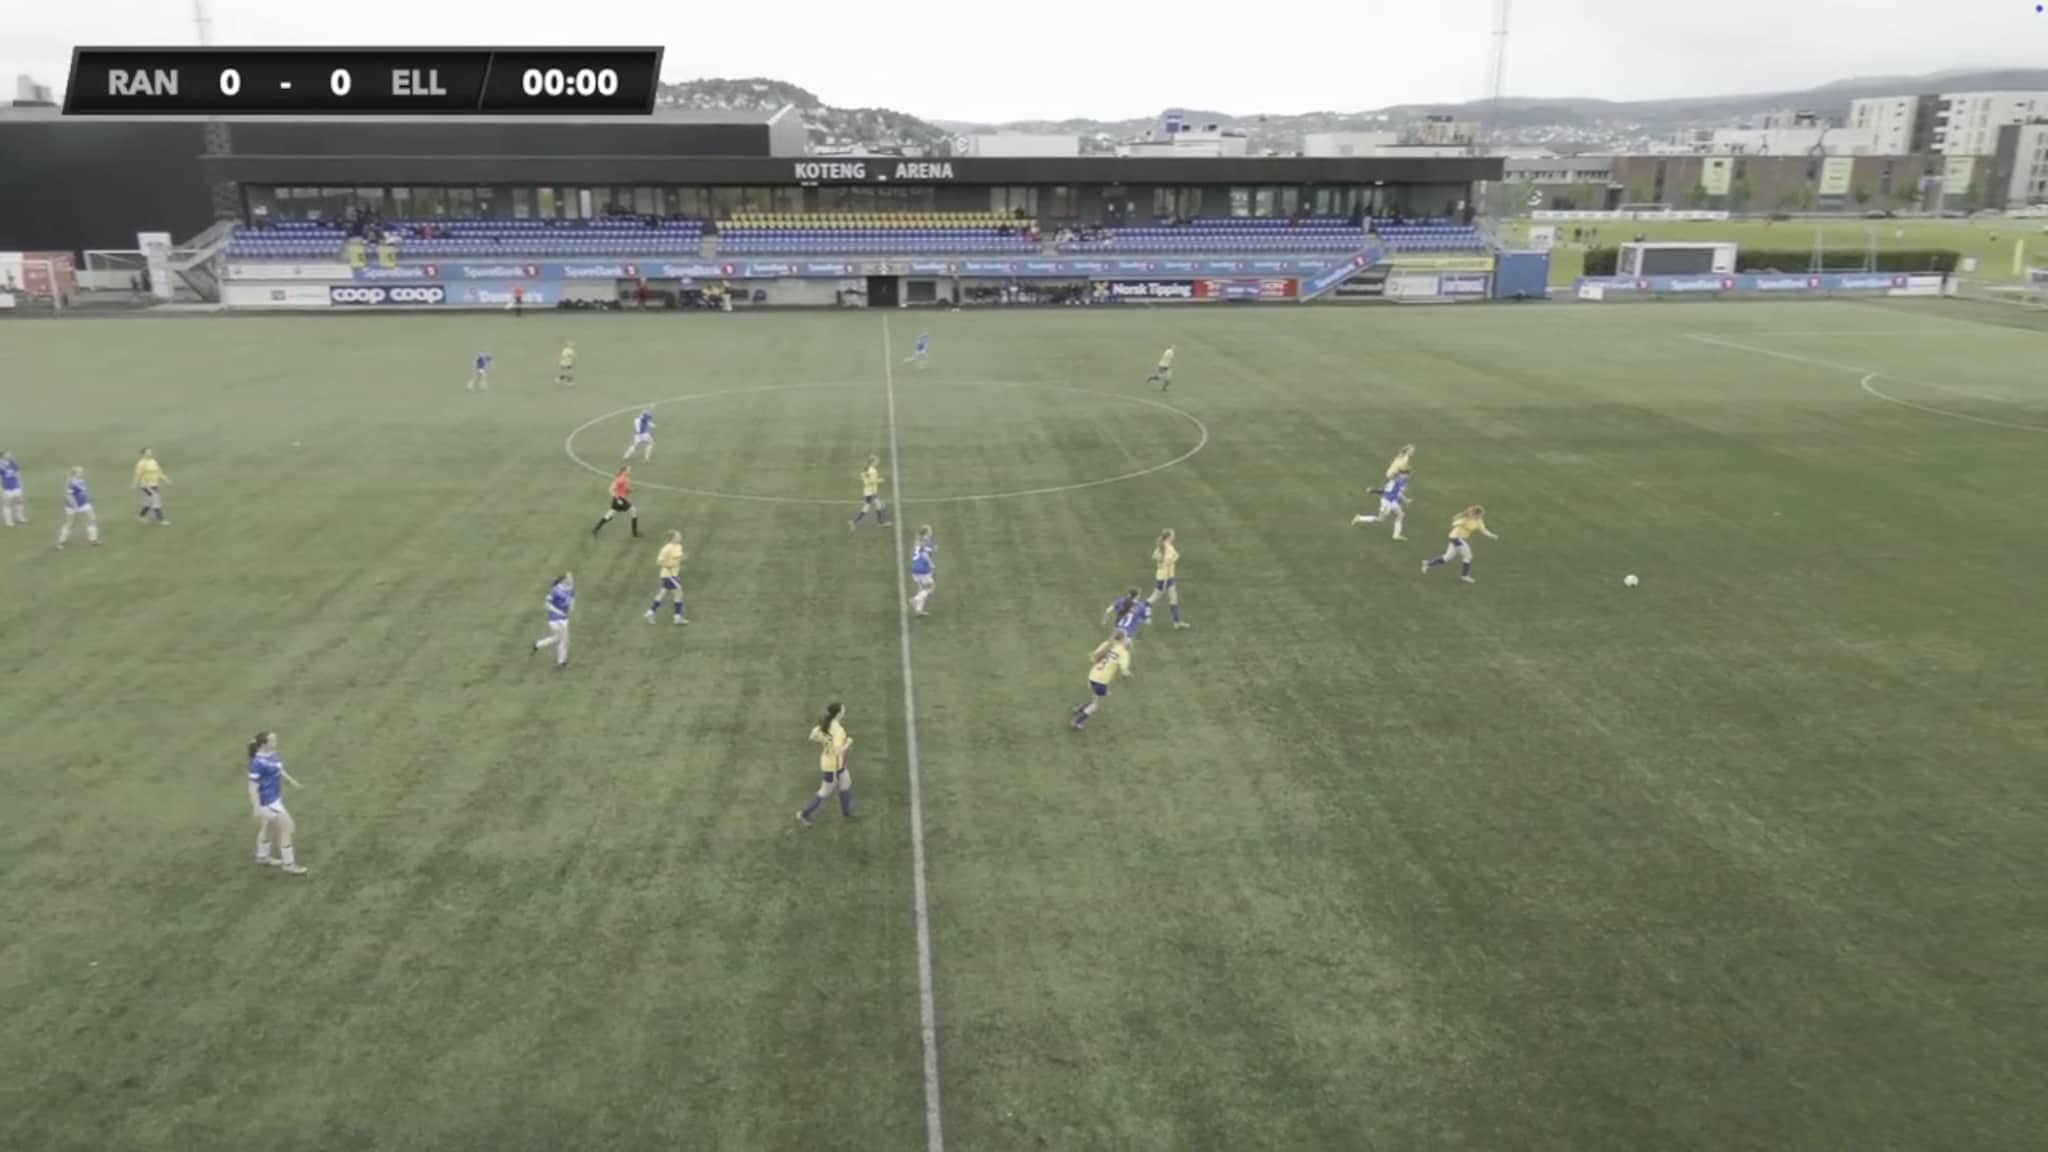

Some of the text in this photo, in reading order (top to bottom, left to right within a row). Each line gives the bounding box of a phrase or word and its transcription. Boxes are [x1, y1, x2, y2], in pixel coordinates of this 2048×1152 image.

[794, 162, 954, 180] KOTENG ARENA
[332, 287, 444, 304] coop coop
[1112, 282, 1147, 296] Norsk
[1148, 282, 1193, 297] Tipping
